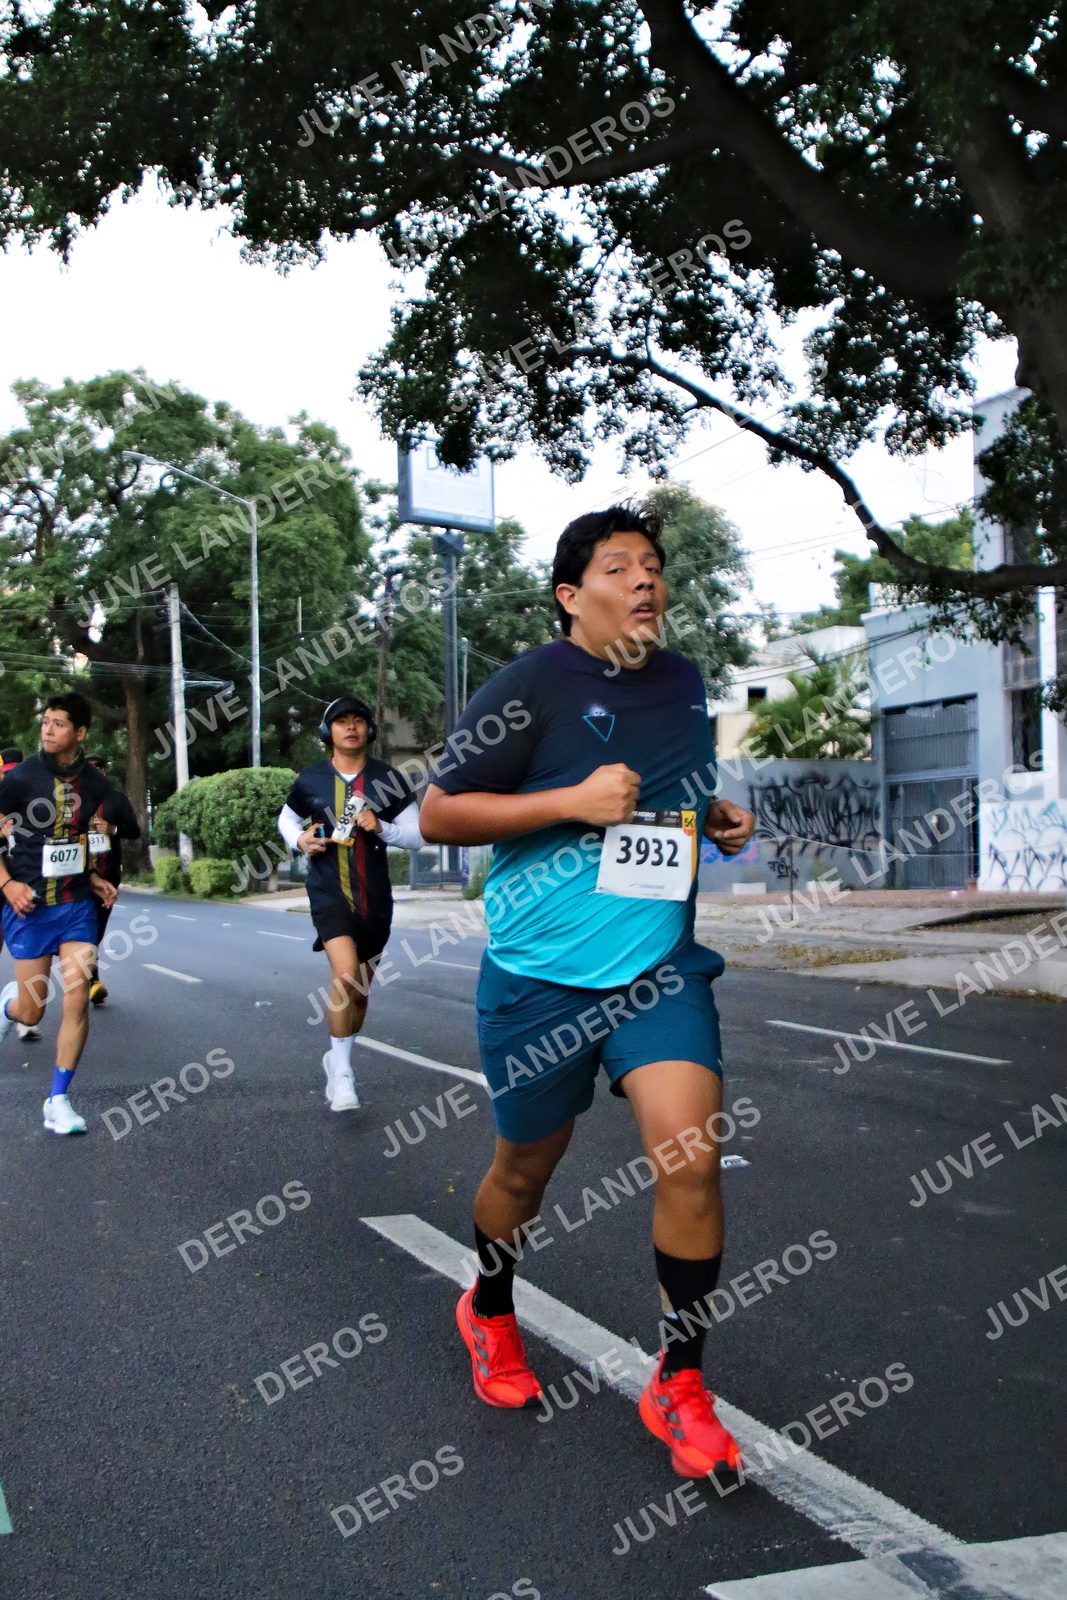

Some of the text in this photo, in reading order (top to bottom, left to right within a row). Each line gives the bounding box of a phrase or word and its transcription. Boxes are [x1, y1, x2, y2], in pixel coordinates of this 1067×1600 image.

[336, 803, 357, 833] 6585
[89, 835, 106, 846] 311
[615, 835, 680, 868] 3932
[50, 847, 79, 863] 6077
